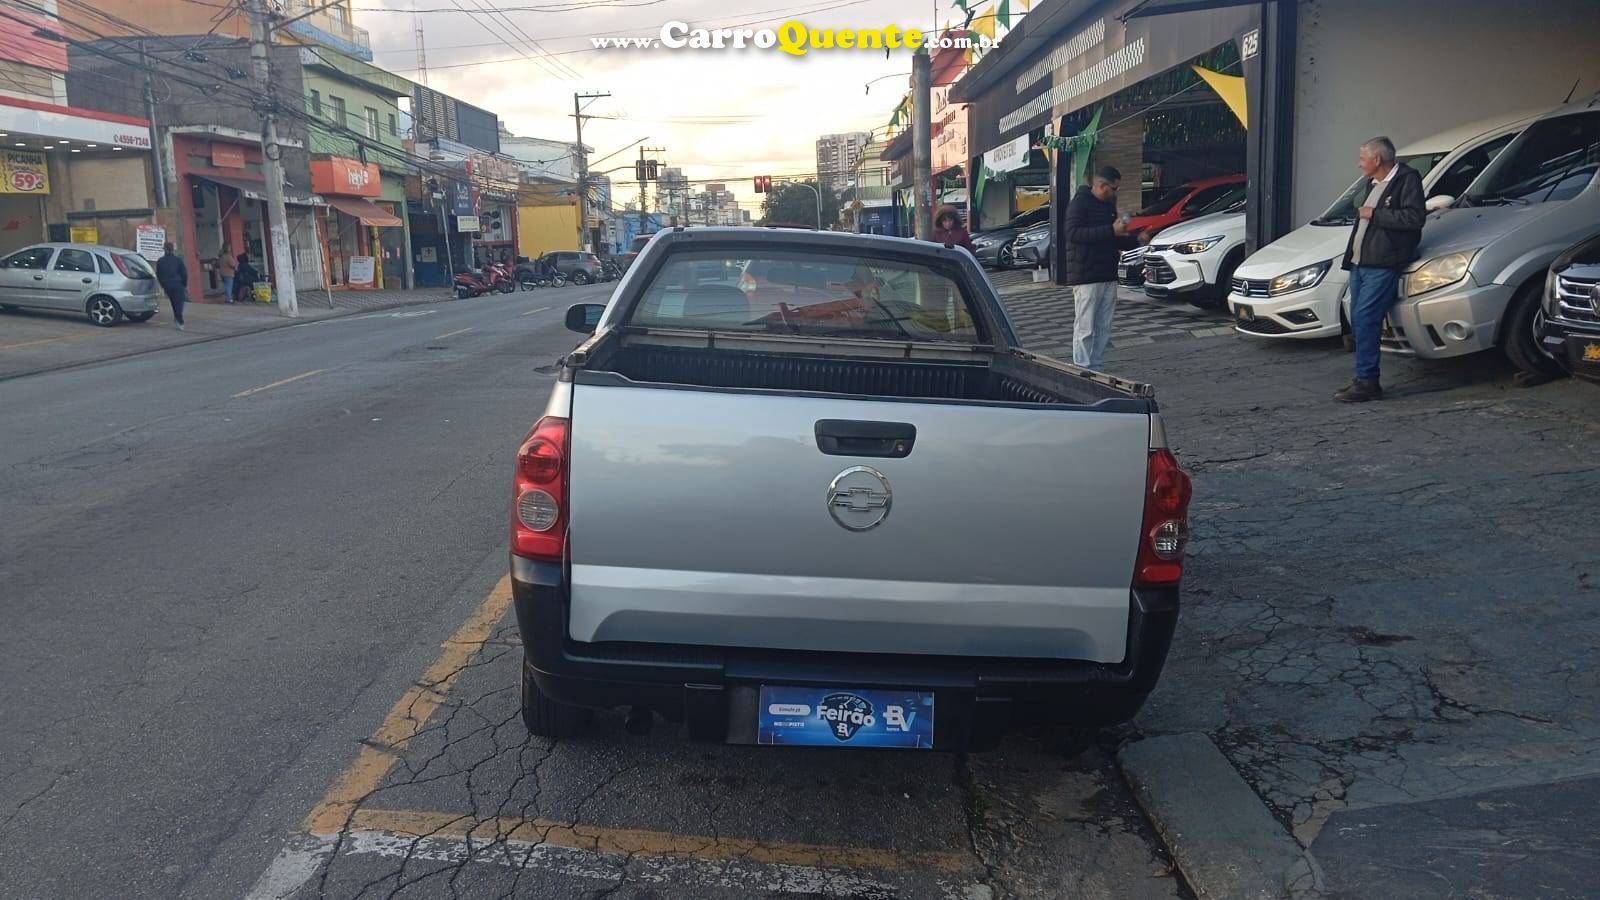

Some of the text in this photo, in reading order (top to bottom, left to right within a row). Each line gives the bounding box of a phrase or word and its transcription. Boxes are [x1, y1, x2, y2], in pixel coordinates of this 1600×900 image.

[1243, 32, 1258, 58] 625
[15, 173, 34, 188] 59
[816, 704, 876, 727] Feirão
